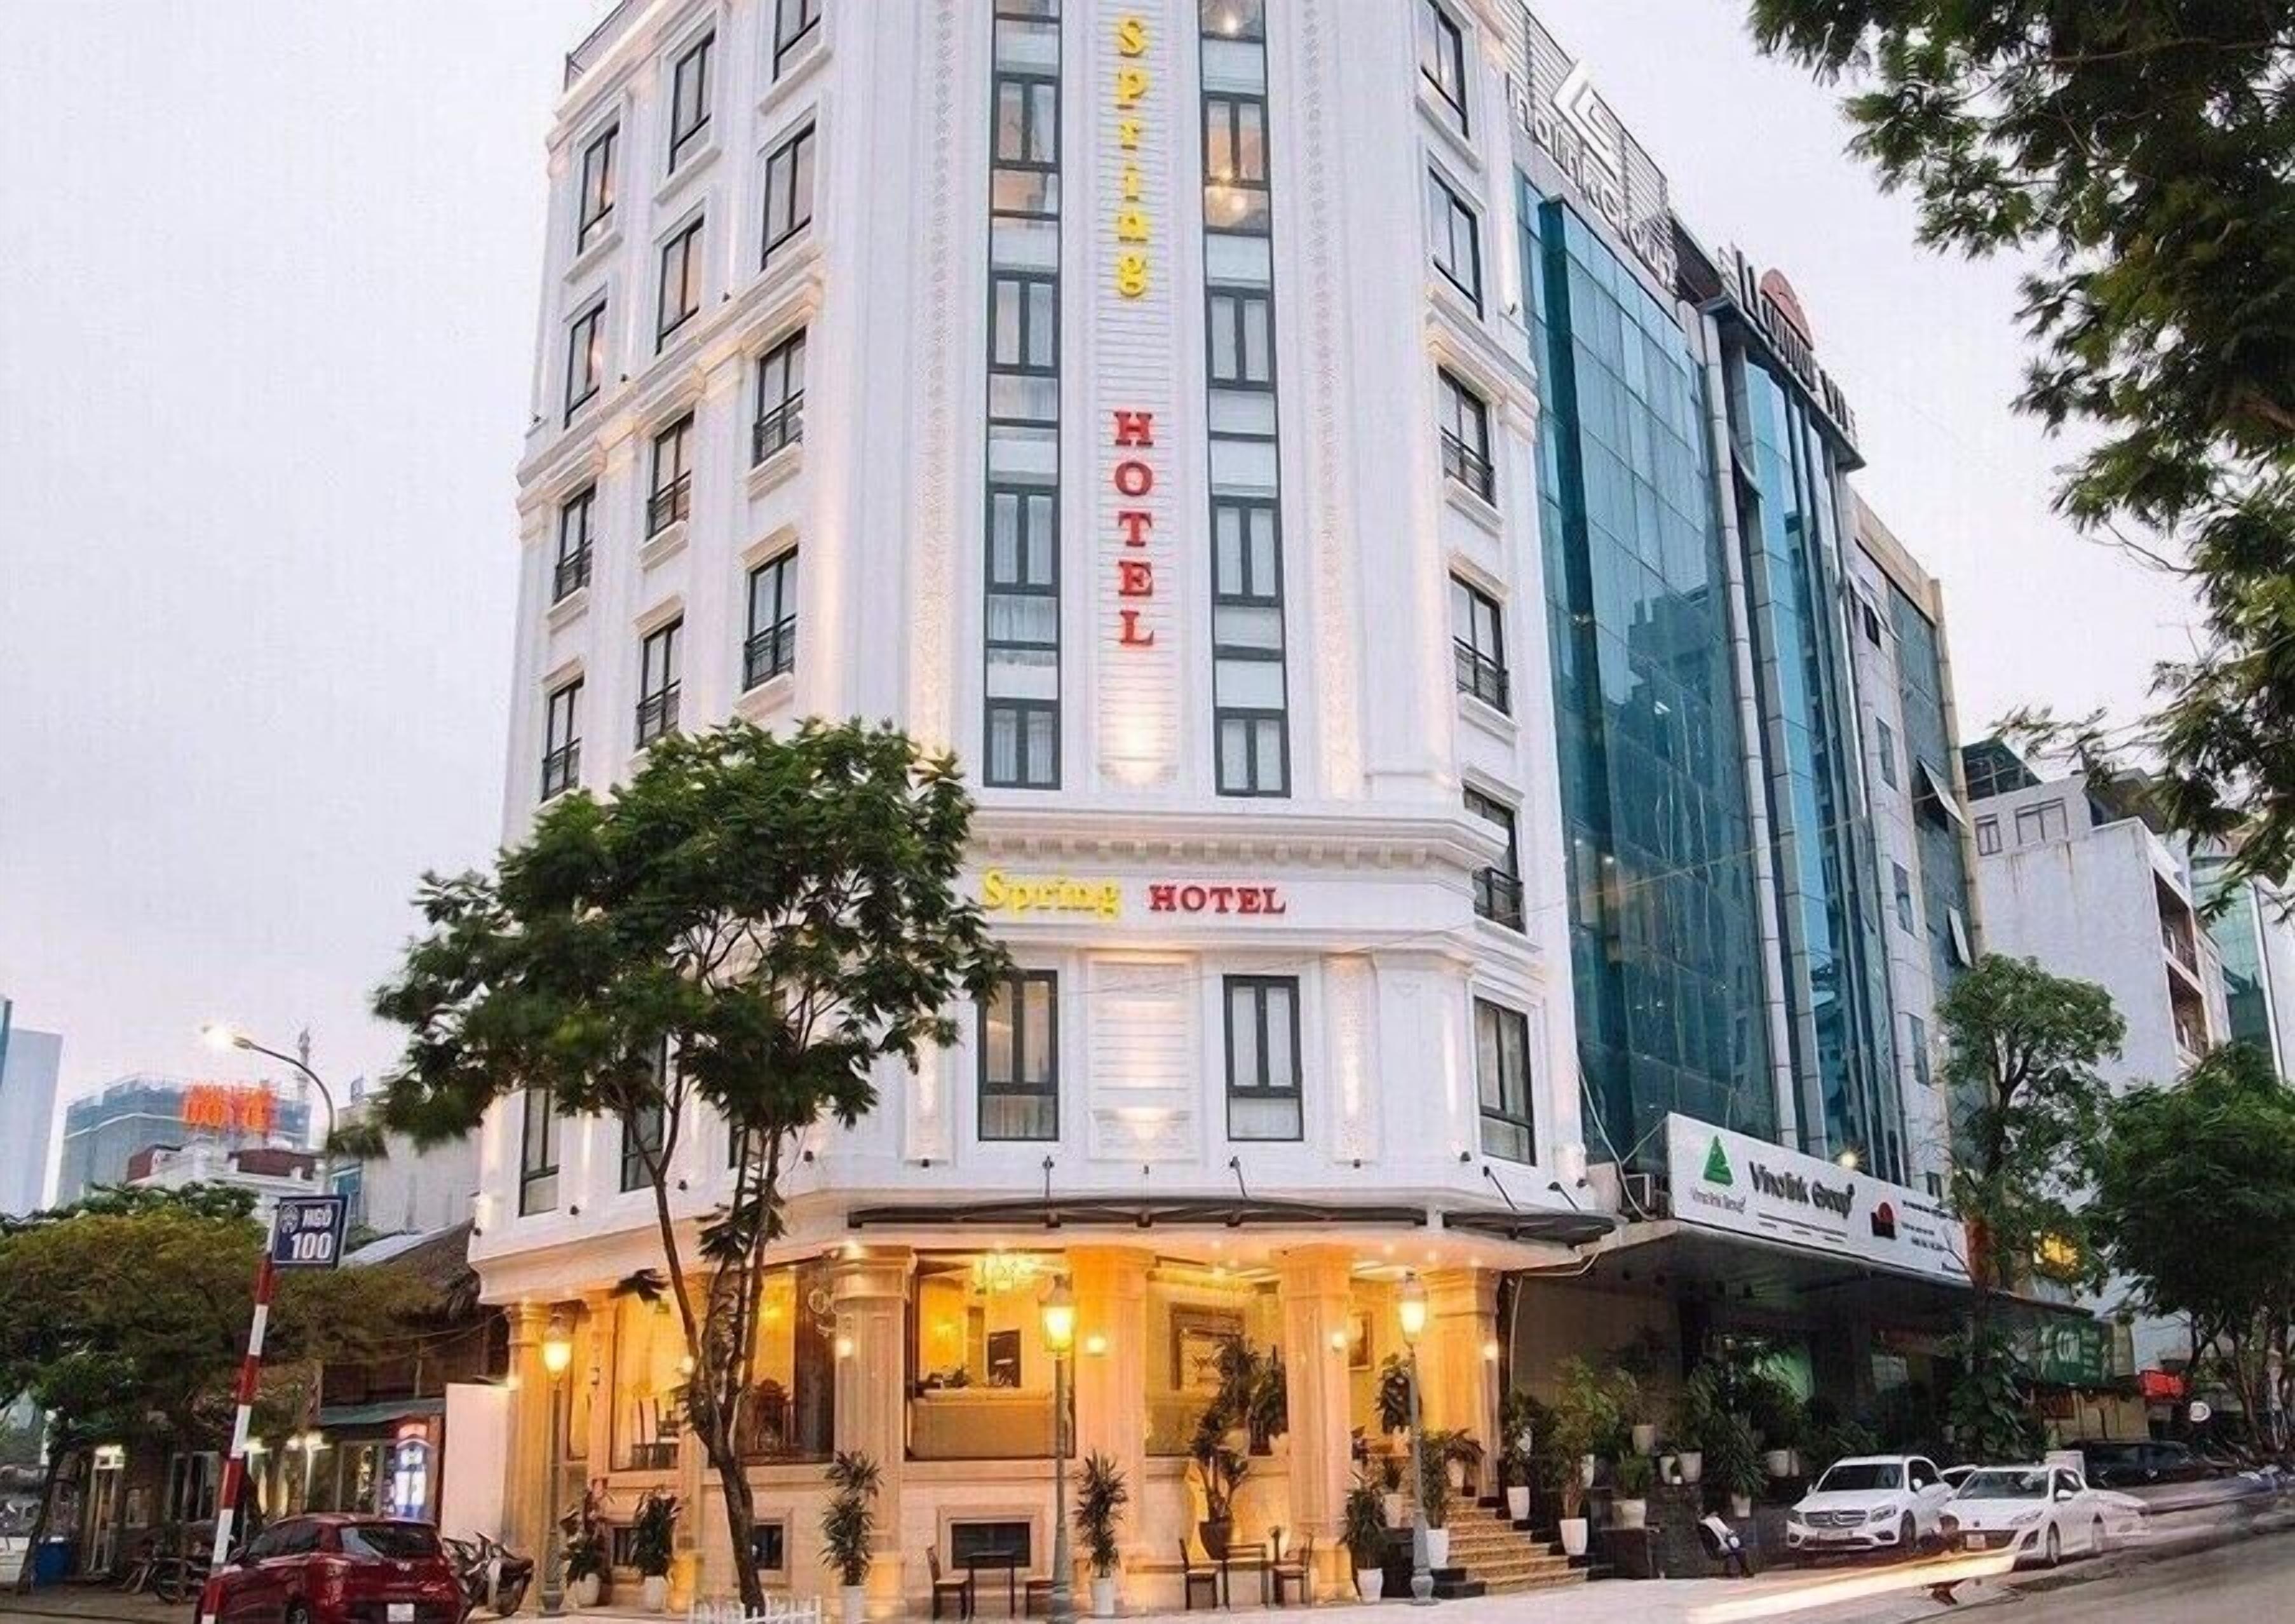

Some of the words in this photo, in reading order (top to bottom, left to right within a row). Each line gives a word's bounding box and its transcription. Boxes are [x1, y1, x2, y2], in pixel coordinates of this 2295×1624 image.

[1118, 17, 1147, 297] Spring
[1114, 411, 1154, 646] HOTEL
[982, 866, 1120, 917] Spring
[1149, 884, 1286, 914] HOTEL
[290, 1232, 333, 1259] 100
